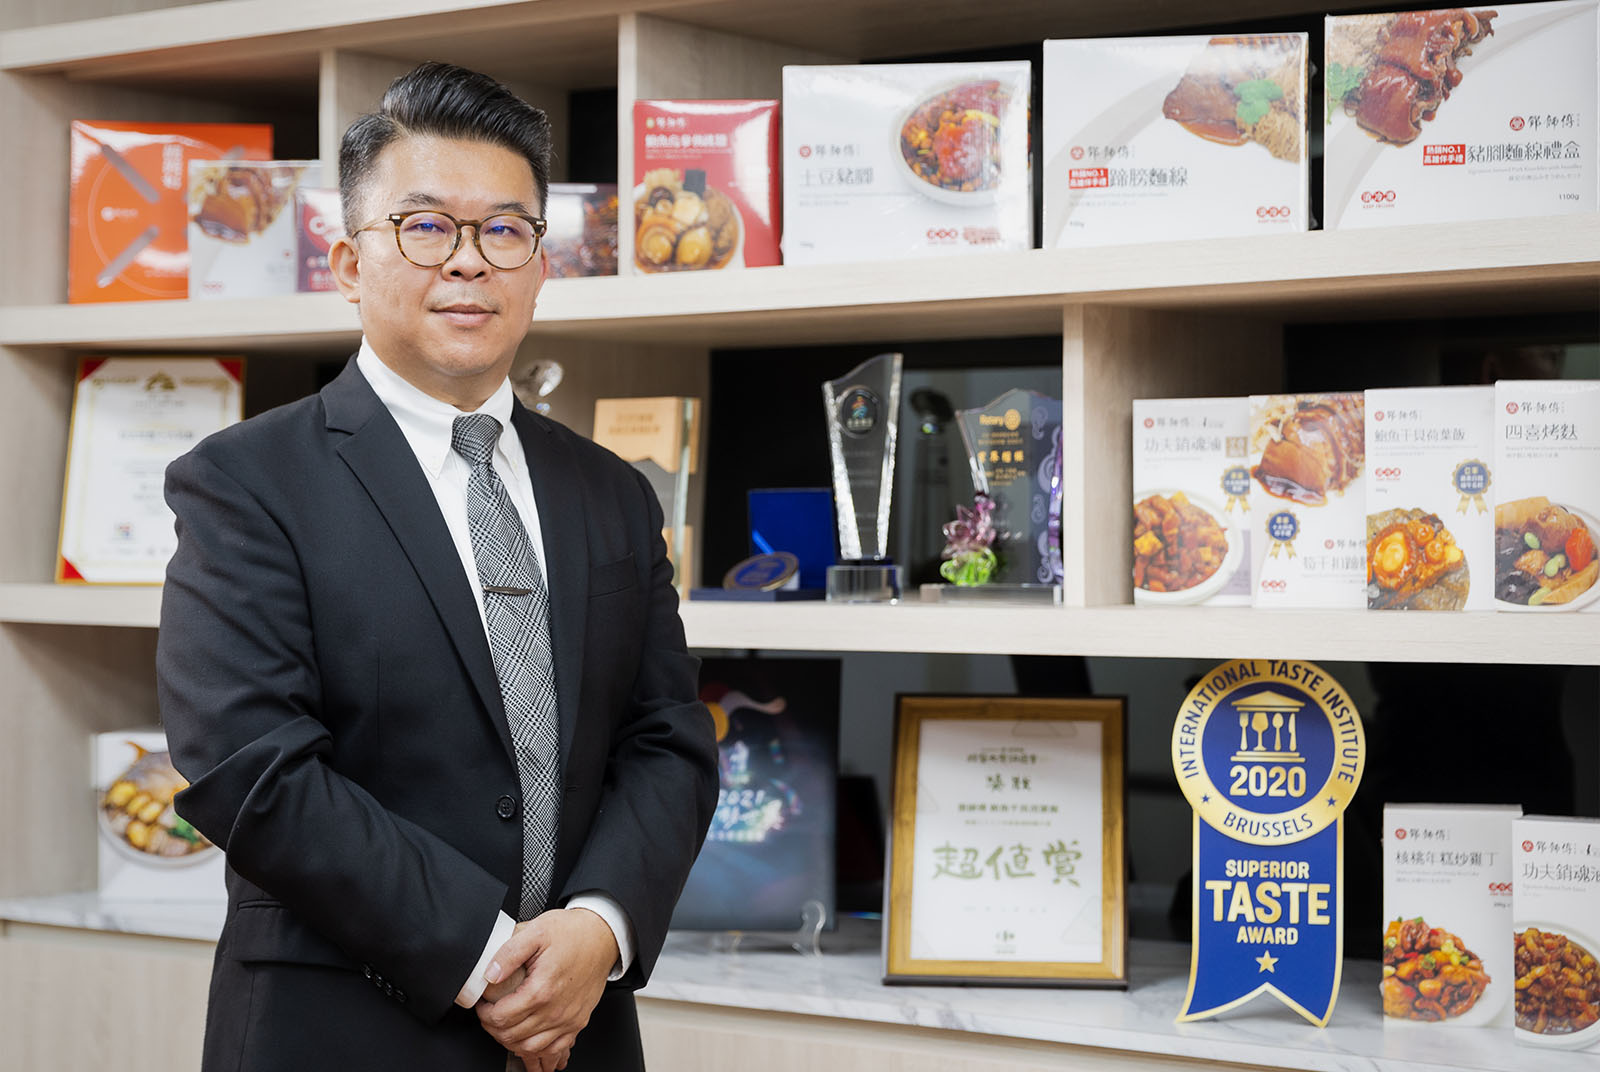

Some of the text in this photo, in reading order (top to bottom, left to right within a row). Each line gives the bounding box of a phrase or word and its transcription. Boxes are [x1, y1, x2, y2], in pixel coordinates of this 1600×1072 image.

[1180, 660, 1359, 784] INTERNATIONAL TASTE INSTITUTE
[1229, 764, 1307, 798] 2020
[1223, 811, 1313, 838] BRUSSELS
[931, 840, 1082, 888] 超值賞
[1225, 859, 1311, 880] SUPERIOR
[1205, 880, 1331, 925] TASTE
[1236, 926, 1299, 945] AWARD
